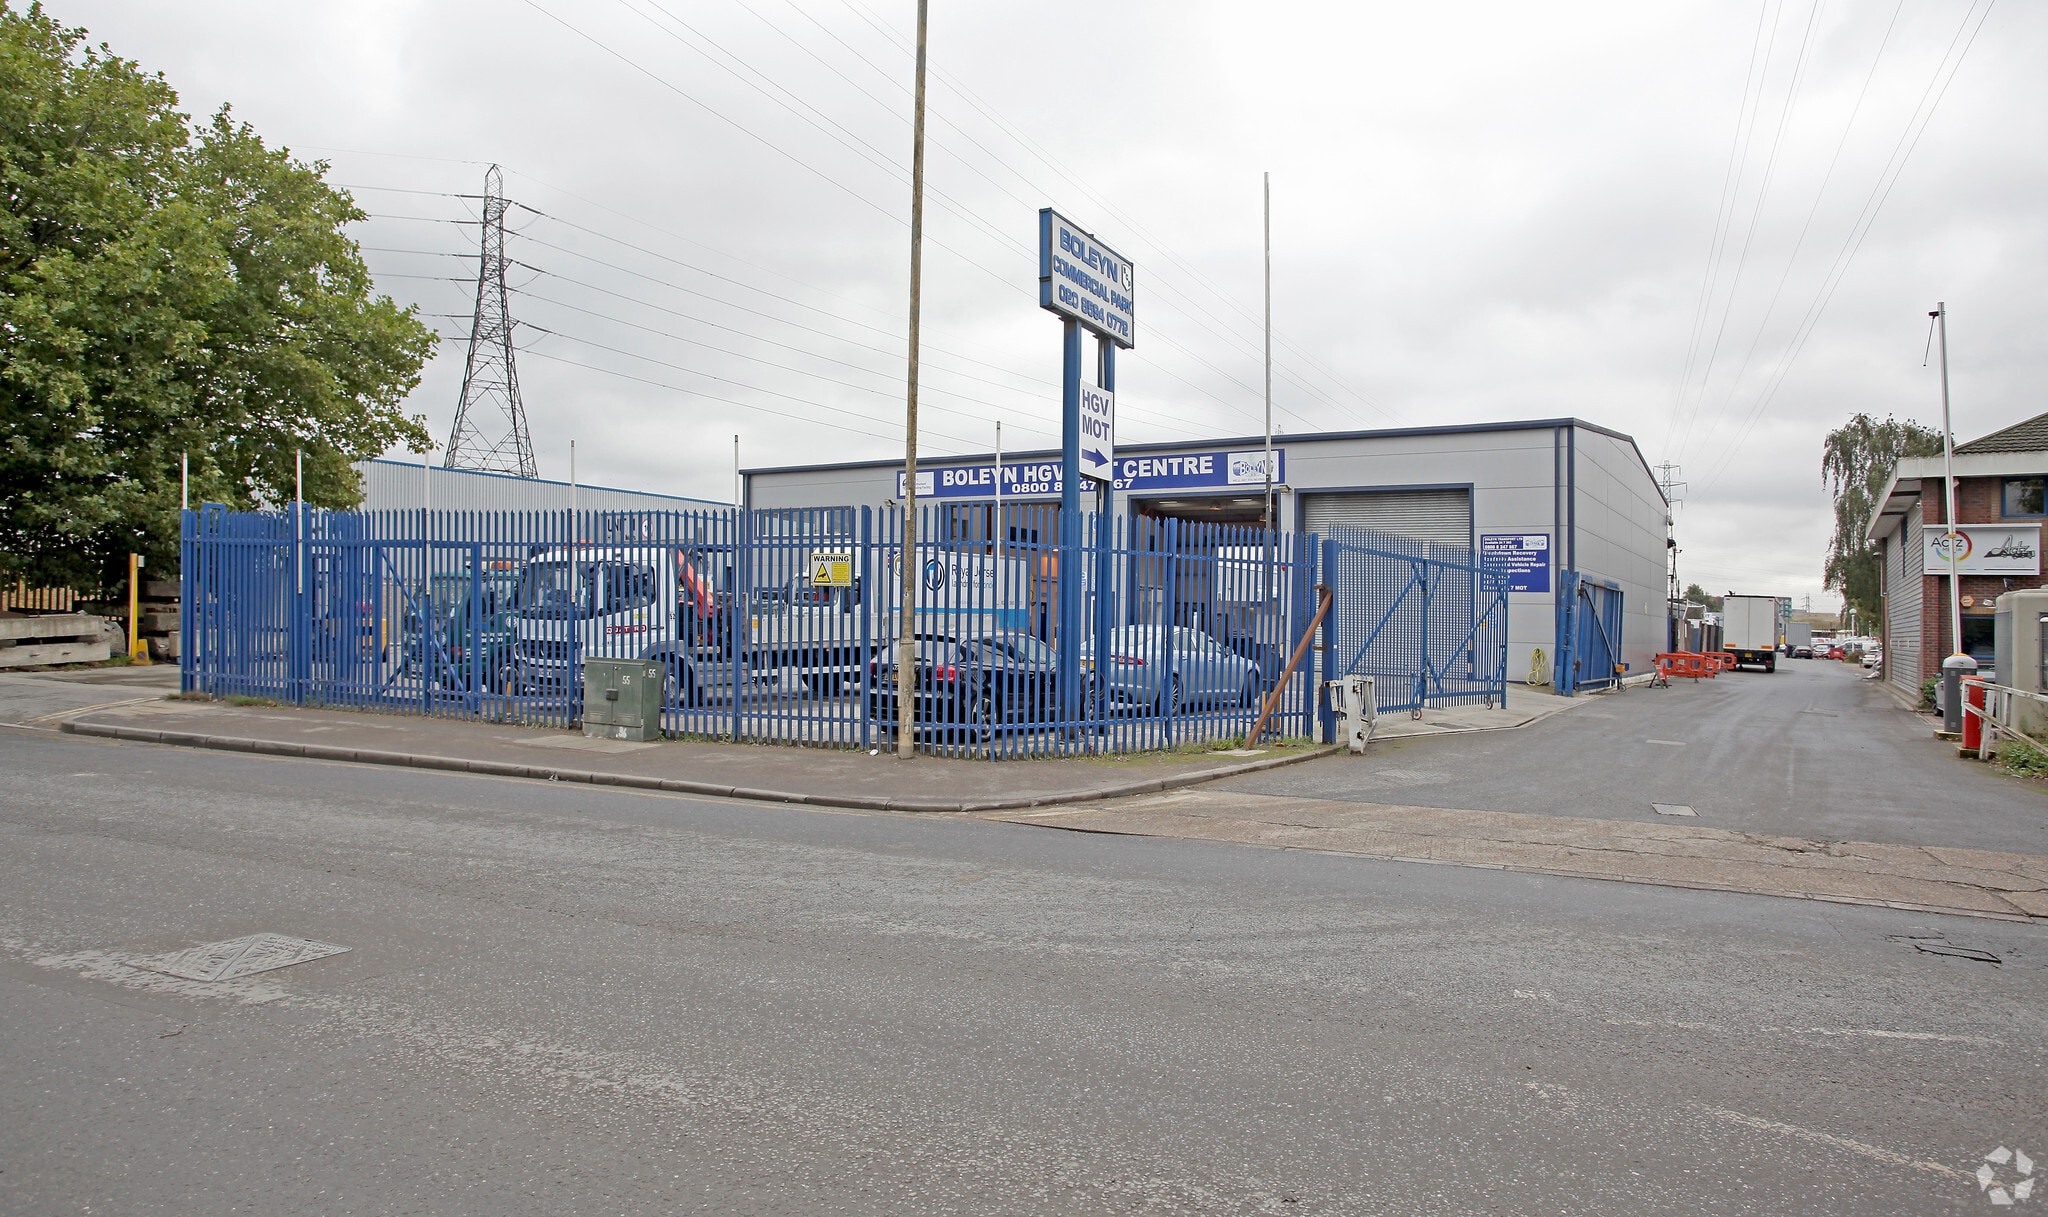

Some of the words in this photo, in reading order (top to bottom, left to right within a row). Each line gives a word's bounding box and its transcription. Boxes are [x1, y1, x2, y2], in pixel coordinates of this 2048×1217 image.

[1060, 226, 1118, 283] BOLEYN
[1053, 254, 1109, 303] COMMERCIAL
[1111, 288, 1132, 316] PARK
[1059, 283, 1078, 310] 020
[1081, 296, 1105, 324] 8594
[1107, 311, 1128, 337] 0772
[1082, 388, 1109, 417] HGV
[1082, 414, 1110, 441] MOT
[942, 466, 1017, 487] BOLEYN
[1123, 456, 1213, 478] CENTRE
[1012, 482, 1049, 494] 0800
[1930, 537, 1963, 547] Acz
